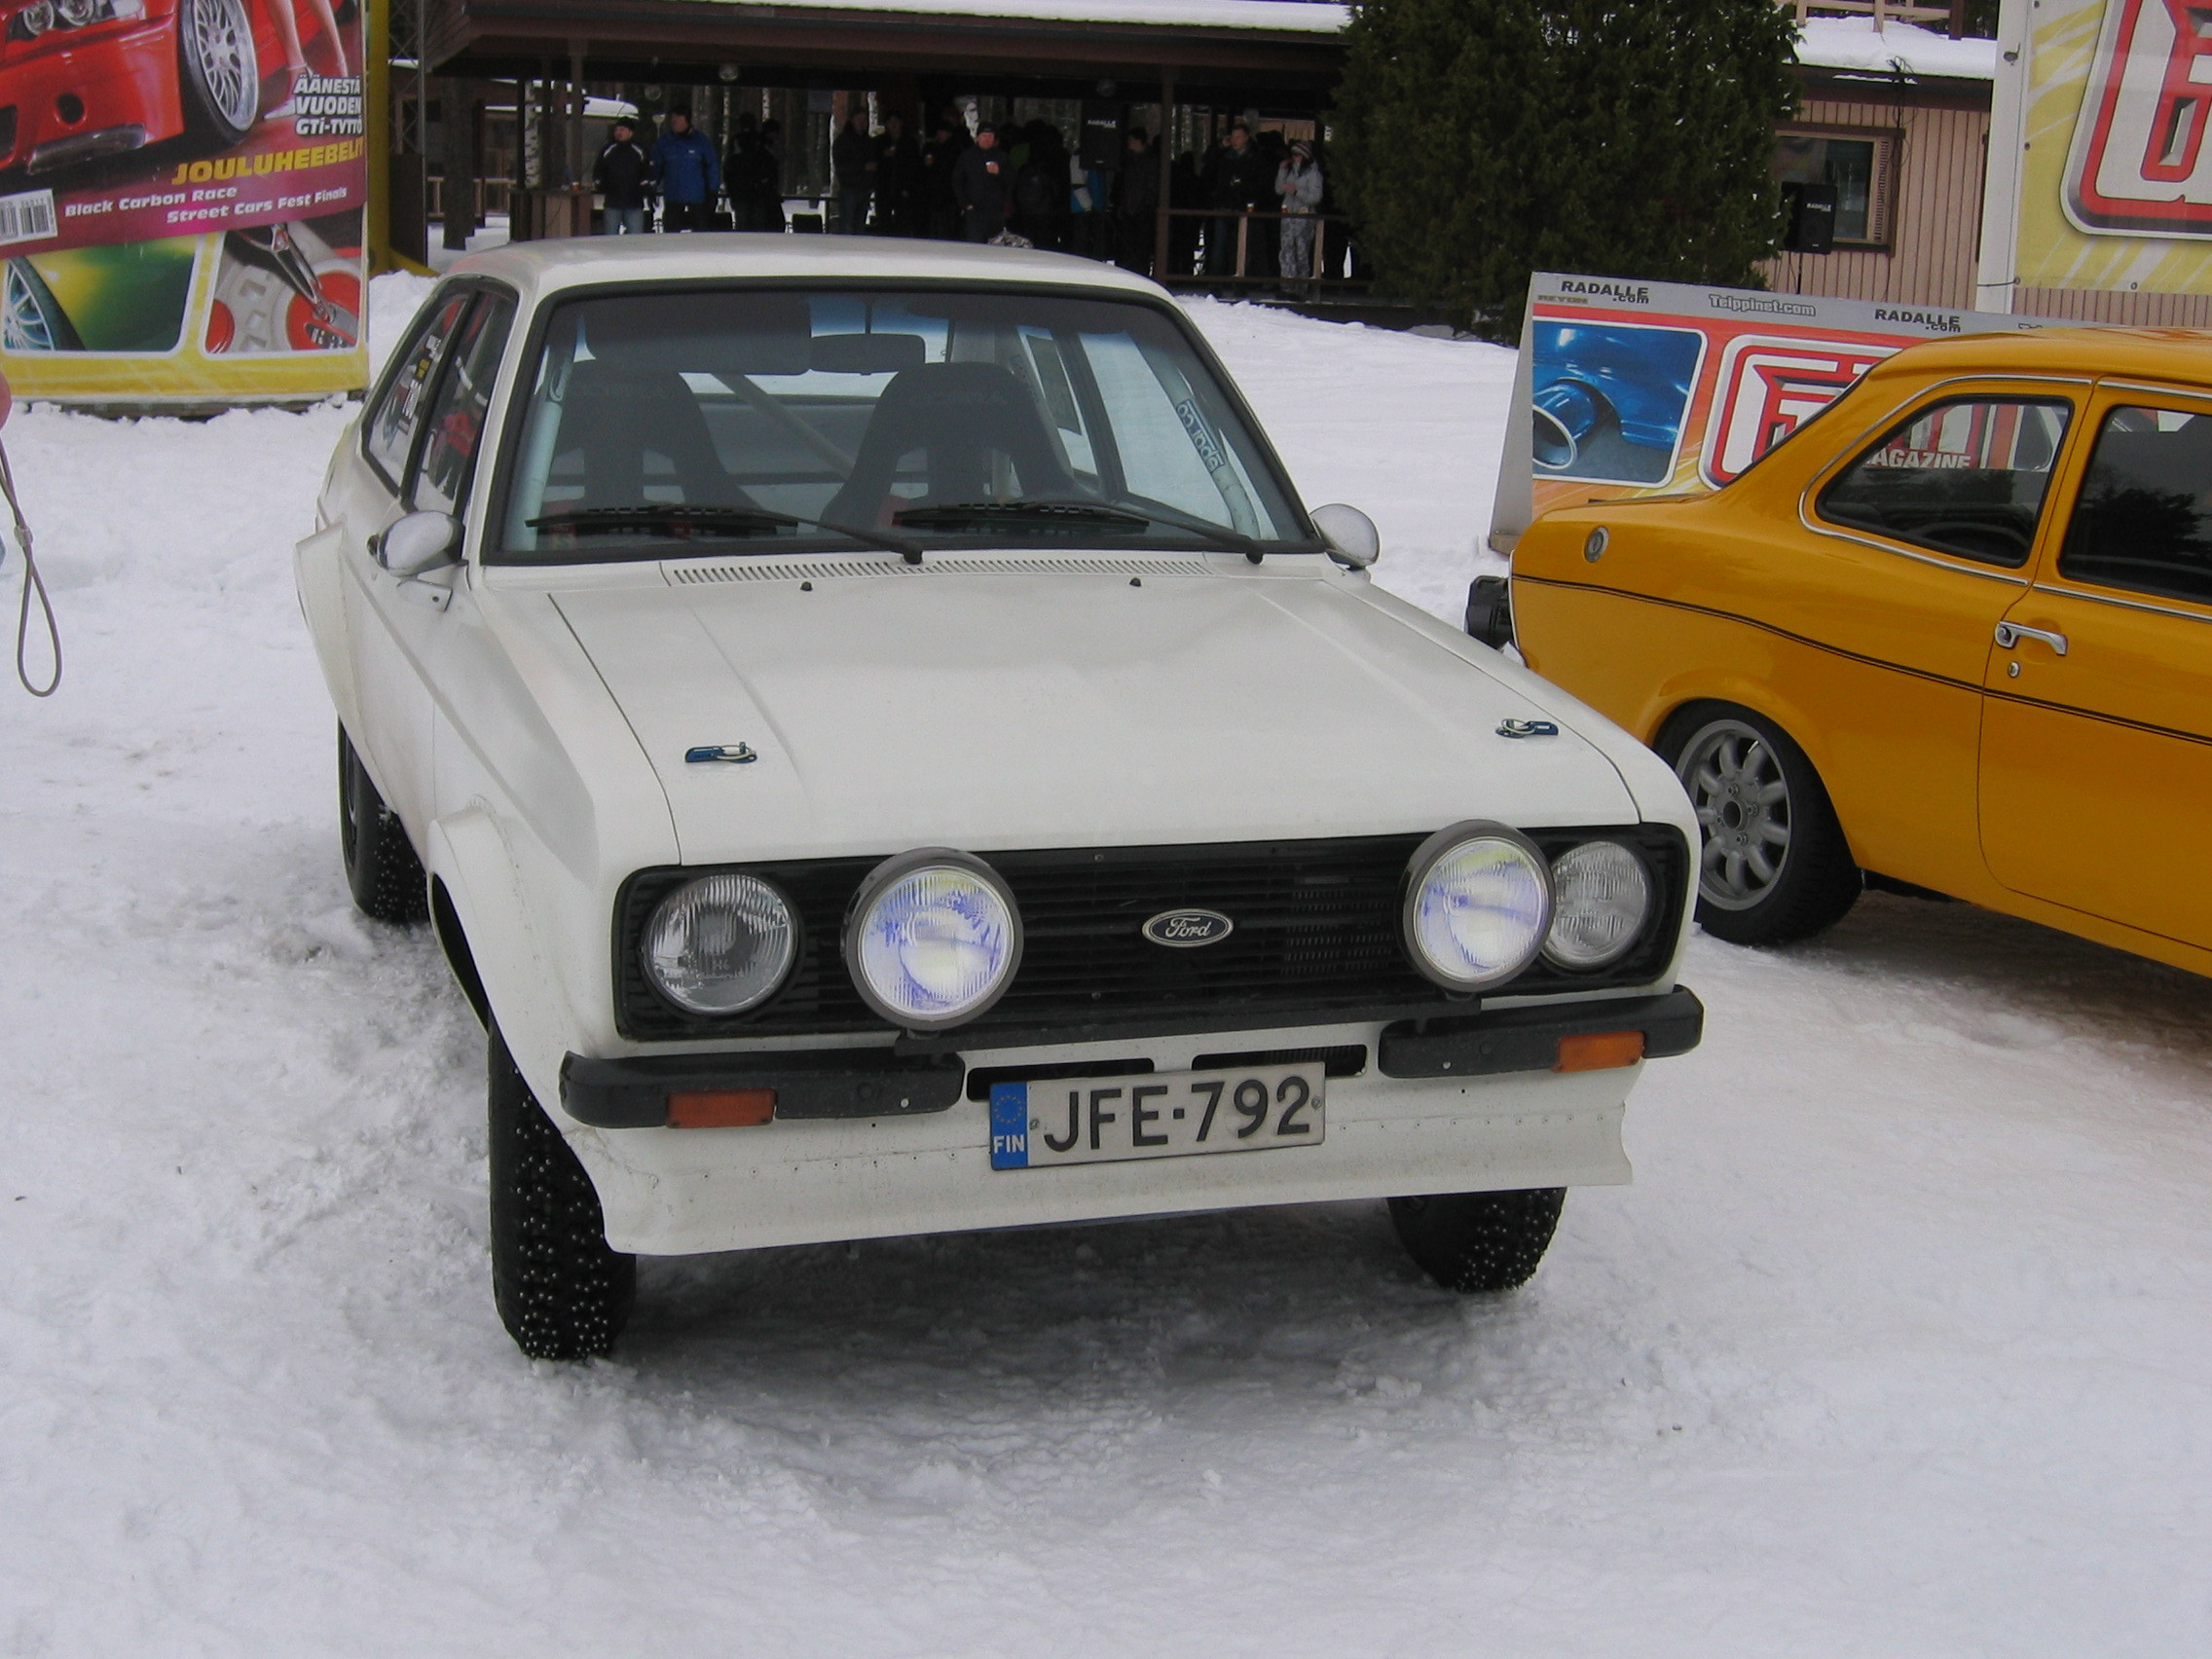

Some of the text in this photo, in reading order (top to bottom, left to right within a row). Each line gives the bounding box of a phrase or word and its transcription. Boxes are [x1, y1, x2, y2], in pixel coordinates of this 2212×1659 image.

[293, 74, 360, 93] ÄÄNESTÄ
[295, 95, 361, 115] VUODEN
[64, 200, 113, 217] Black
[118, 193, 186, 210] Carbon
[192, 186, 238, 203] Race
[166, 186, 348, 224] Street Cars Fest Finals
[1561, 280, 1649, 298] RADALLE
[1612, 295, 1649, 304] .com
[1874, 309, 1961, 325] RADALLE
[1925, 323, 1961, 333] .com
[1868, 447, 1972, 469] AGAZINE
[1165, 917, 1212, 938] Ford
[993, 1134, 1024, 1154] FIN
